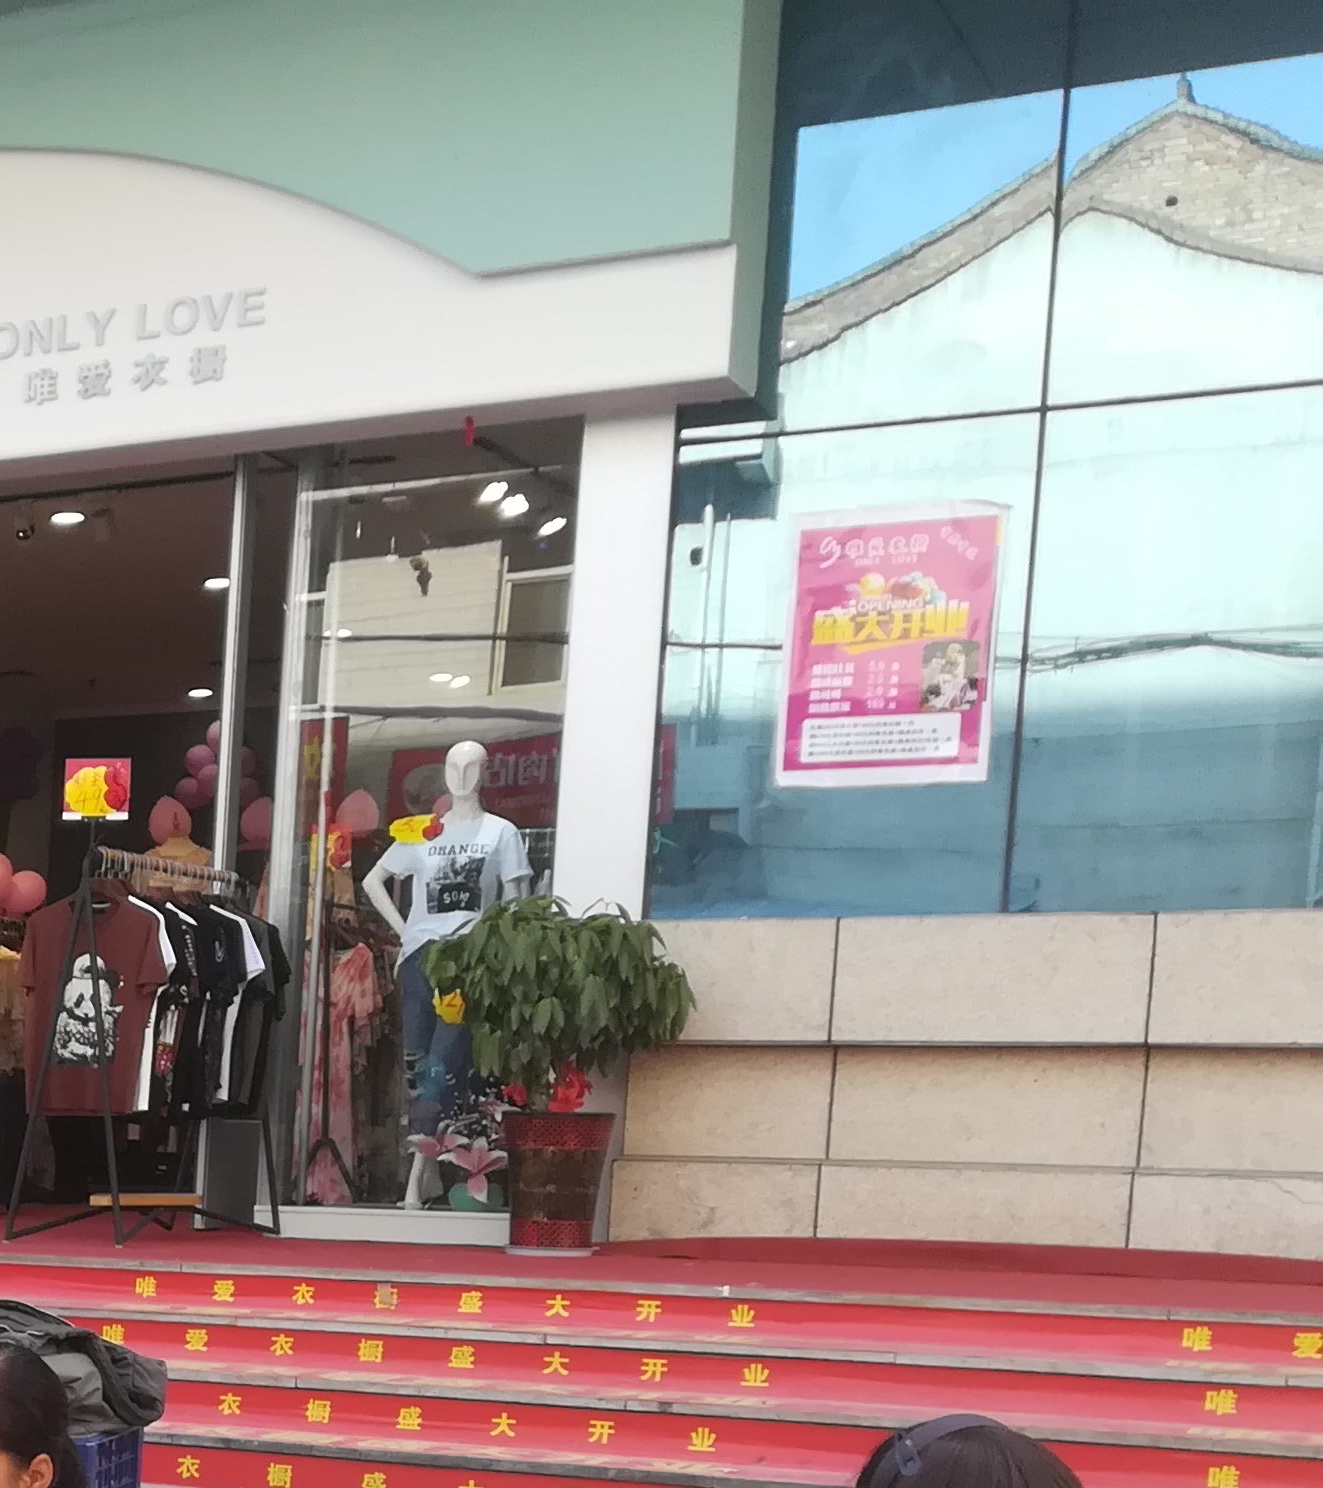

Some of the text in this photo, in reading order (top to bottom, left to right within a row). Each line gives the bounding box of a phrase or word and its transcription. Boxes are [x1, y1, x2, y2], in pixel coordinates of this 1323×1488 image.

[135, 286, 267, 341] LOVE
[24, 344, 228, 405] 唯爱衣橱
[427, 842, 491, 857] ORANGE
